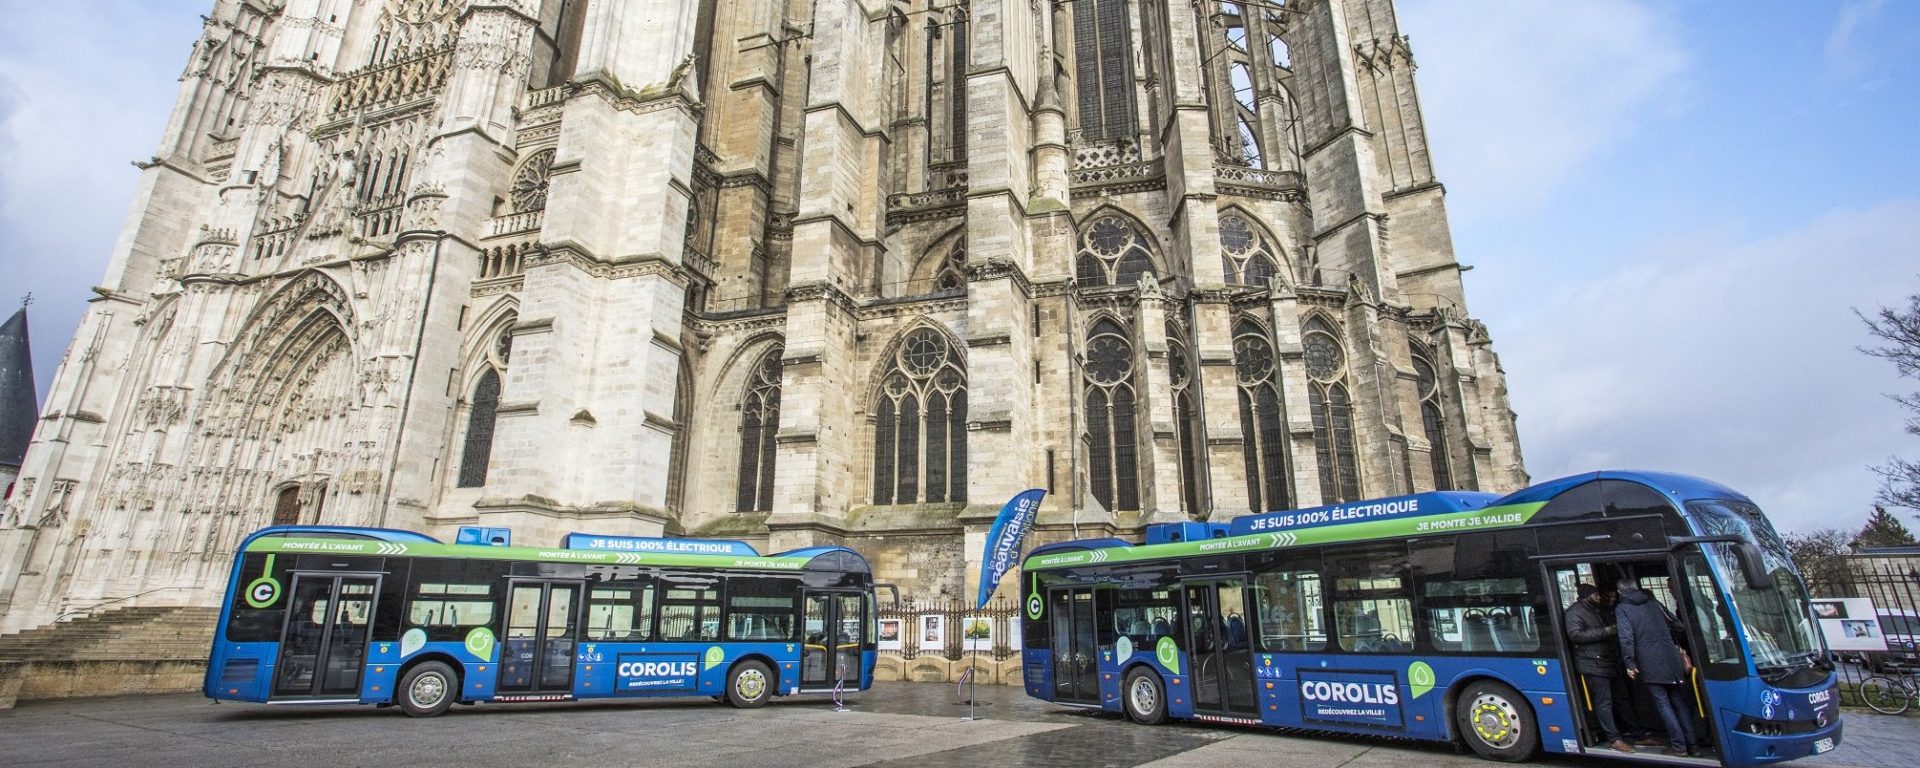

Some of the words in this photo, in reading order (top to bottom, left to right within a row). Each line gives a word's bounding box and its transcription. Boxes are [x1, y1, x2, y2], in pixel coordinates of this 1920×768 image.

[1251, 519, 1266, 530] JE
[1267, 515, 1294, 527] SUIS
[1296, 511, 1329, 525] 100%
[1331, 499, 1418, 521] ÉLECTRIQUE
[1417, 522, 1429, 531] JE
[1430, 518, 1466, 530] MONTE
[1467, 517, 1481, 526] JE
[1482, 513, 1521, 525] VALIDE
[282, 541, 320, 550] MONTÉE
[328, 543, 364, 551] L'AVANT
[590, 539, 605, 549] JE
[607, 540, 633, 549] SUIS
[635, 540, 664, 550] 100%
[666, 540, 732, 553] ÉLECTRIQUE
[1199, 541, 1226, 551] MONTÉE
[1233, 538, 1261, 548] L'AVANT
[539, 551, 570, 559] MONTÉE
[577, 552, 607, 560] L'AVANT
[618, 662, 697, 677] COROLIS
[1302, 681, 1398, 705] COROLIS
[1317, 708, 1357, 716] REDÉCOUVREZ
